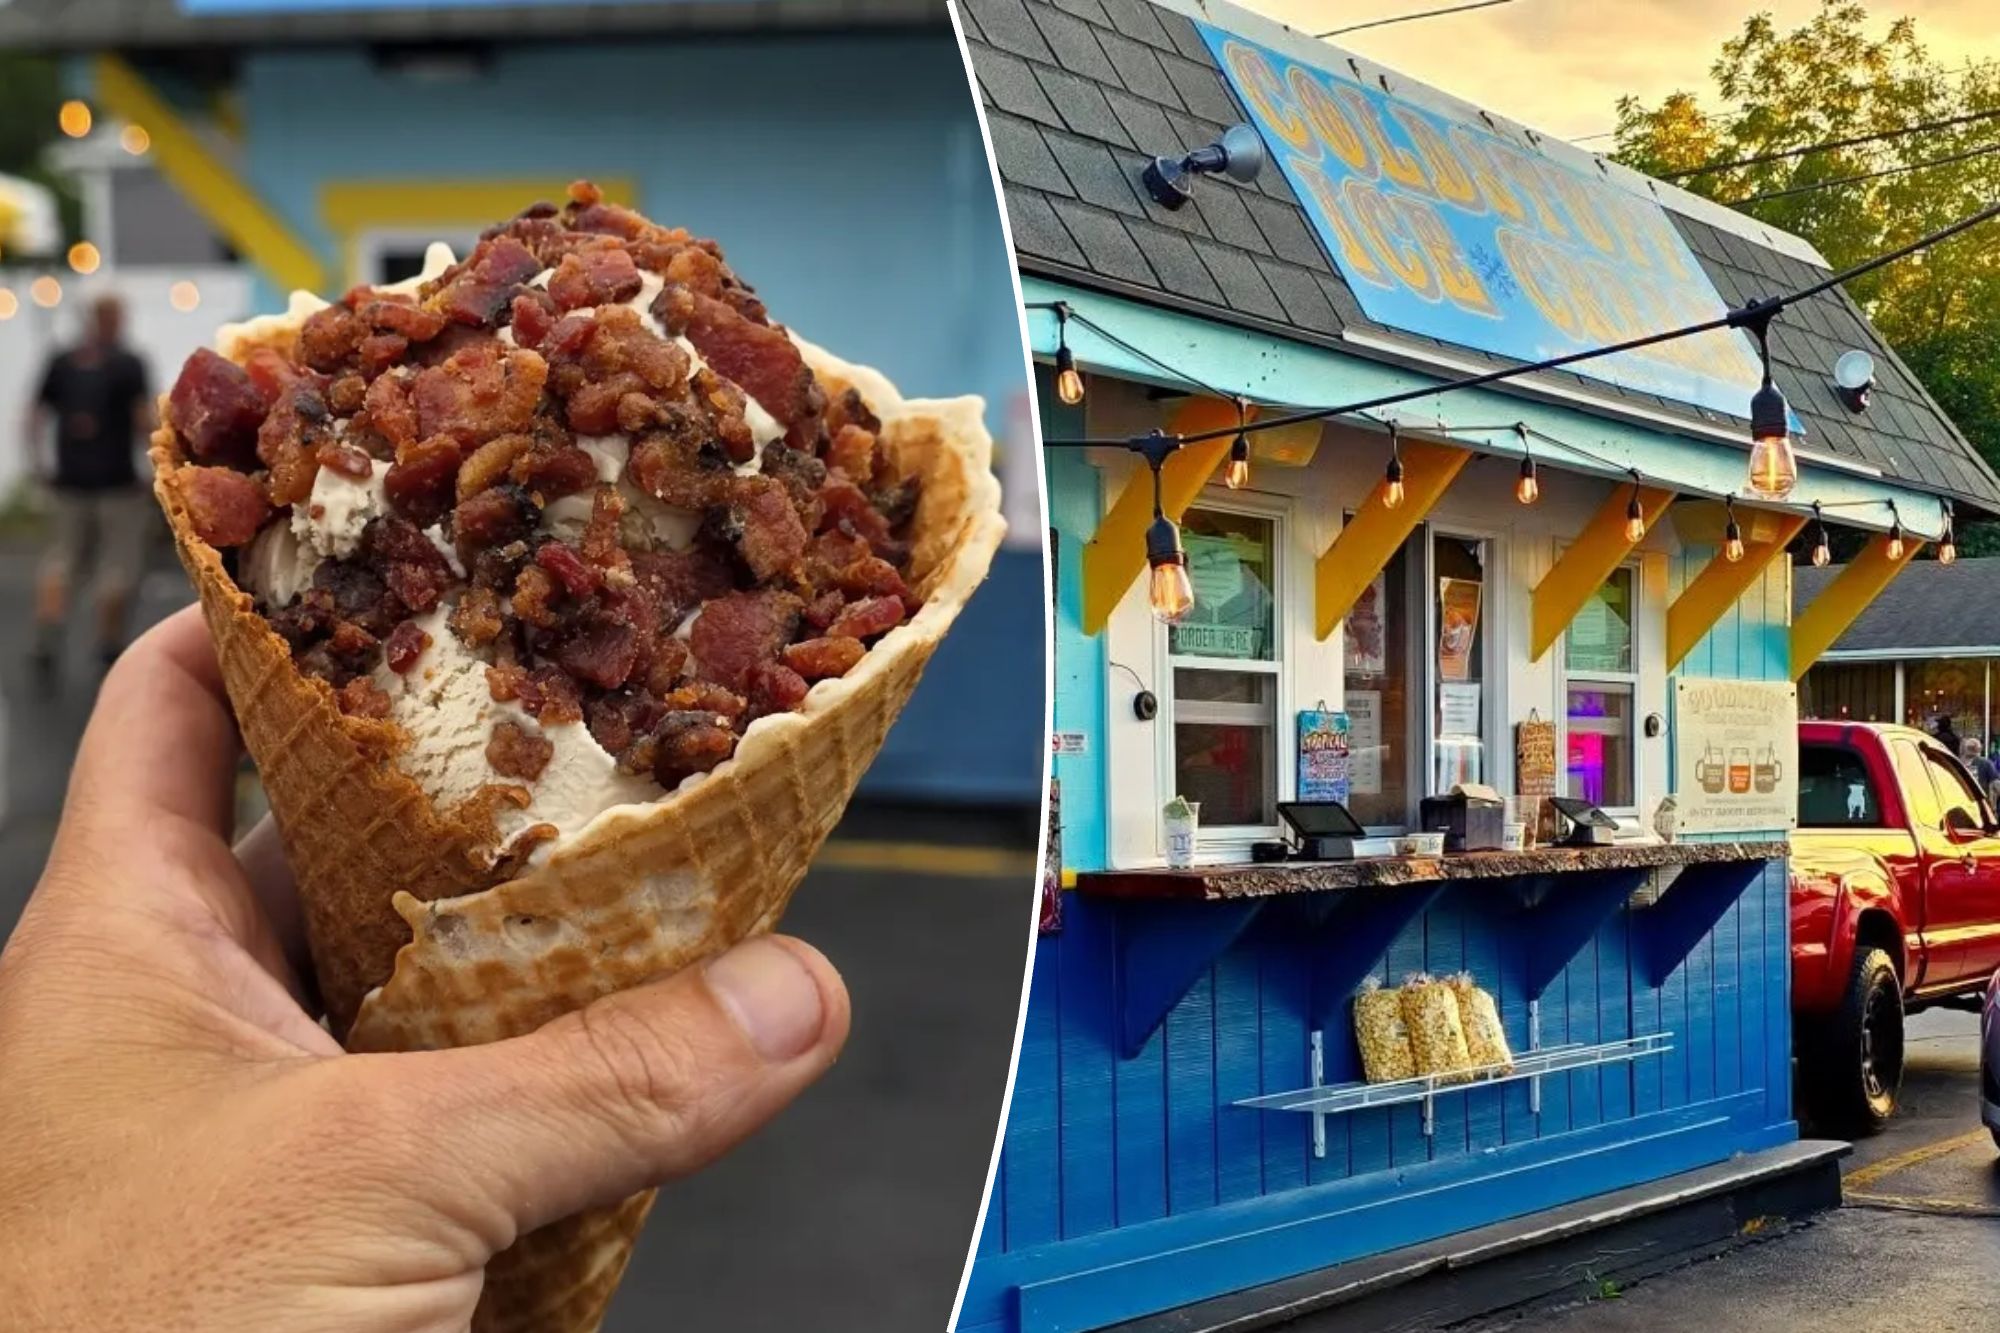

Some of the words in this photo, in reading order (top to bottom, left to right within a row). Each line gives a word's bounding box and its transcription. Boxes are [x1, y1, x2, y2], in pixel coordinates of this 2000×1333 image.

[1289, 154, 1501, 319] ICE
[1180, 626, 1216, 648] ORDER
[1222, 630, 1249, 652] HERE
